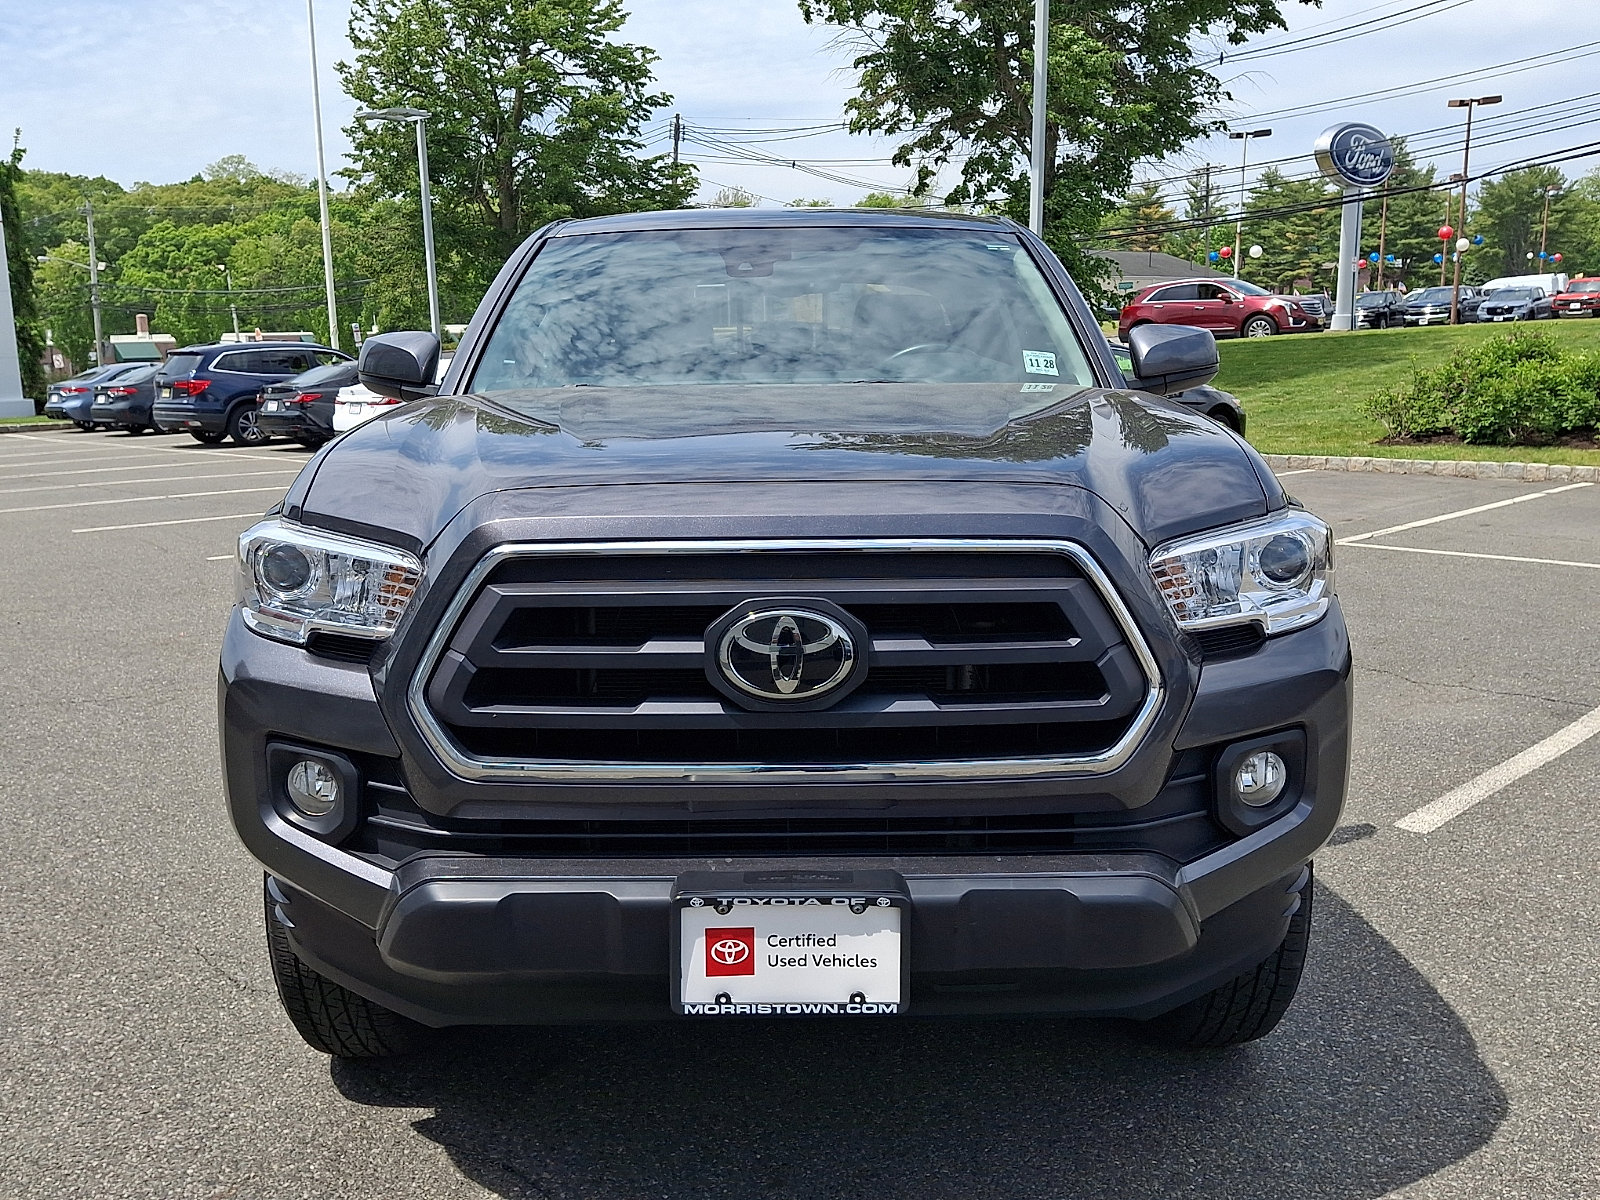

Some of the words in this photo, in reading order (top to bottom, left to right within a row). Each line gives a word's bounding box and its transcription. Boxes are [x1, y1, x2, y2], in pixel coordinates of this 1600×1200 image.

[1345, 134, 1384, 174] Ford
[1029, 358, 1041, 368] 11
[1043, 359, 1055, 369] 28
[716, 897, 822, 906] TOYOTA
[831, 897, 866, 906] OF
[767, 934, 837, 948] Certified
[767, 954, 808, 968] Used
[812, 954, 878, 968] Vehicles
[684, 1003, 898, 1015] MORRISTOWN.COM
